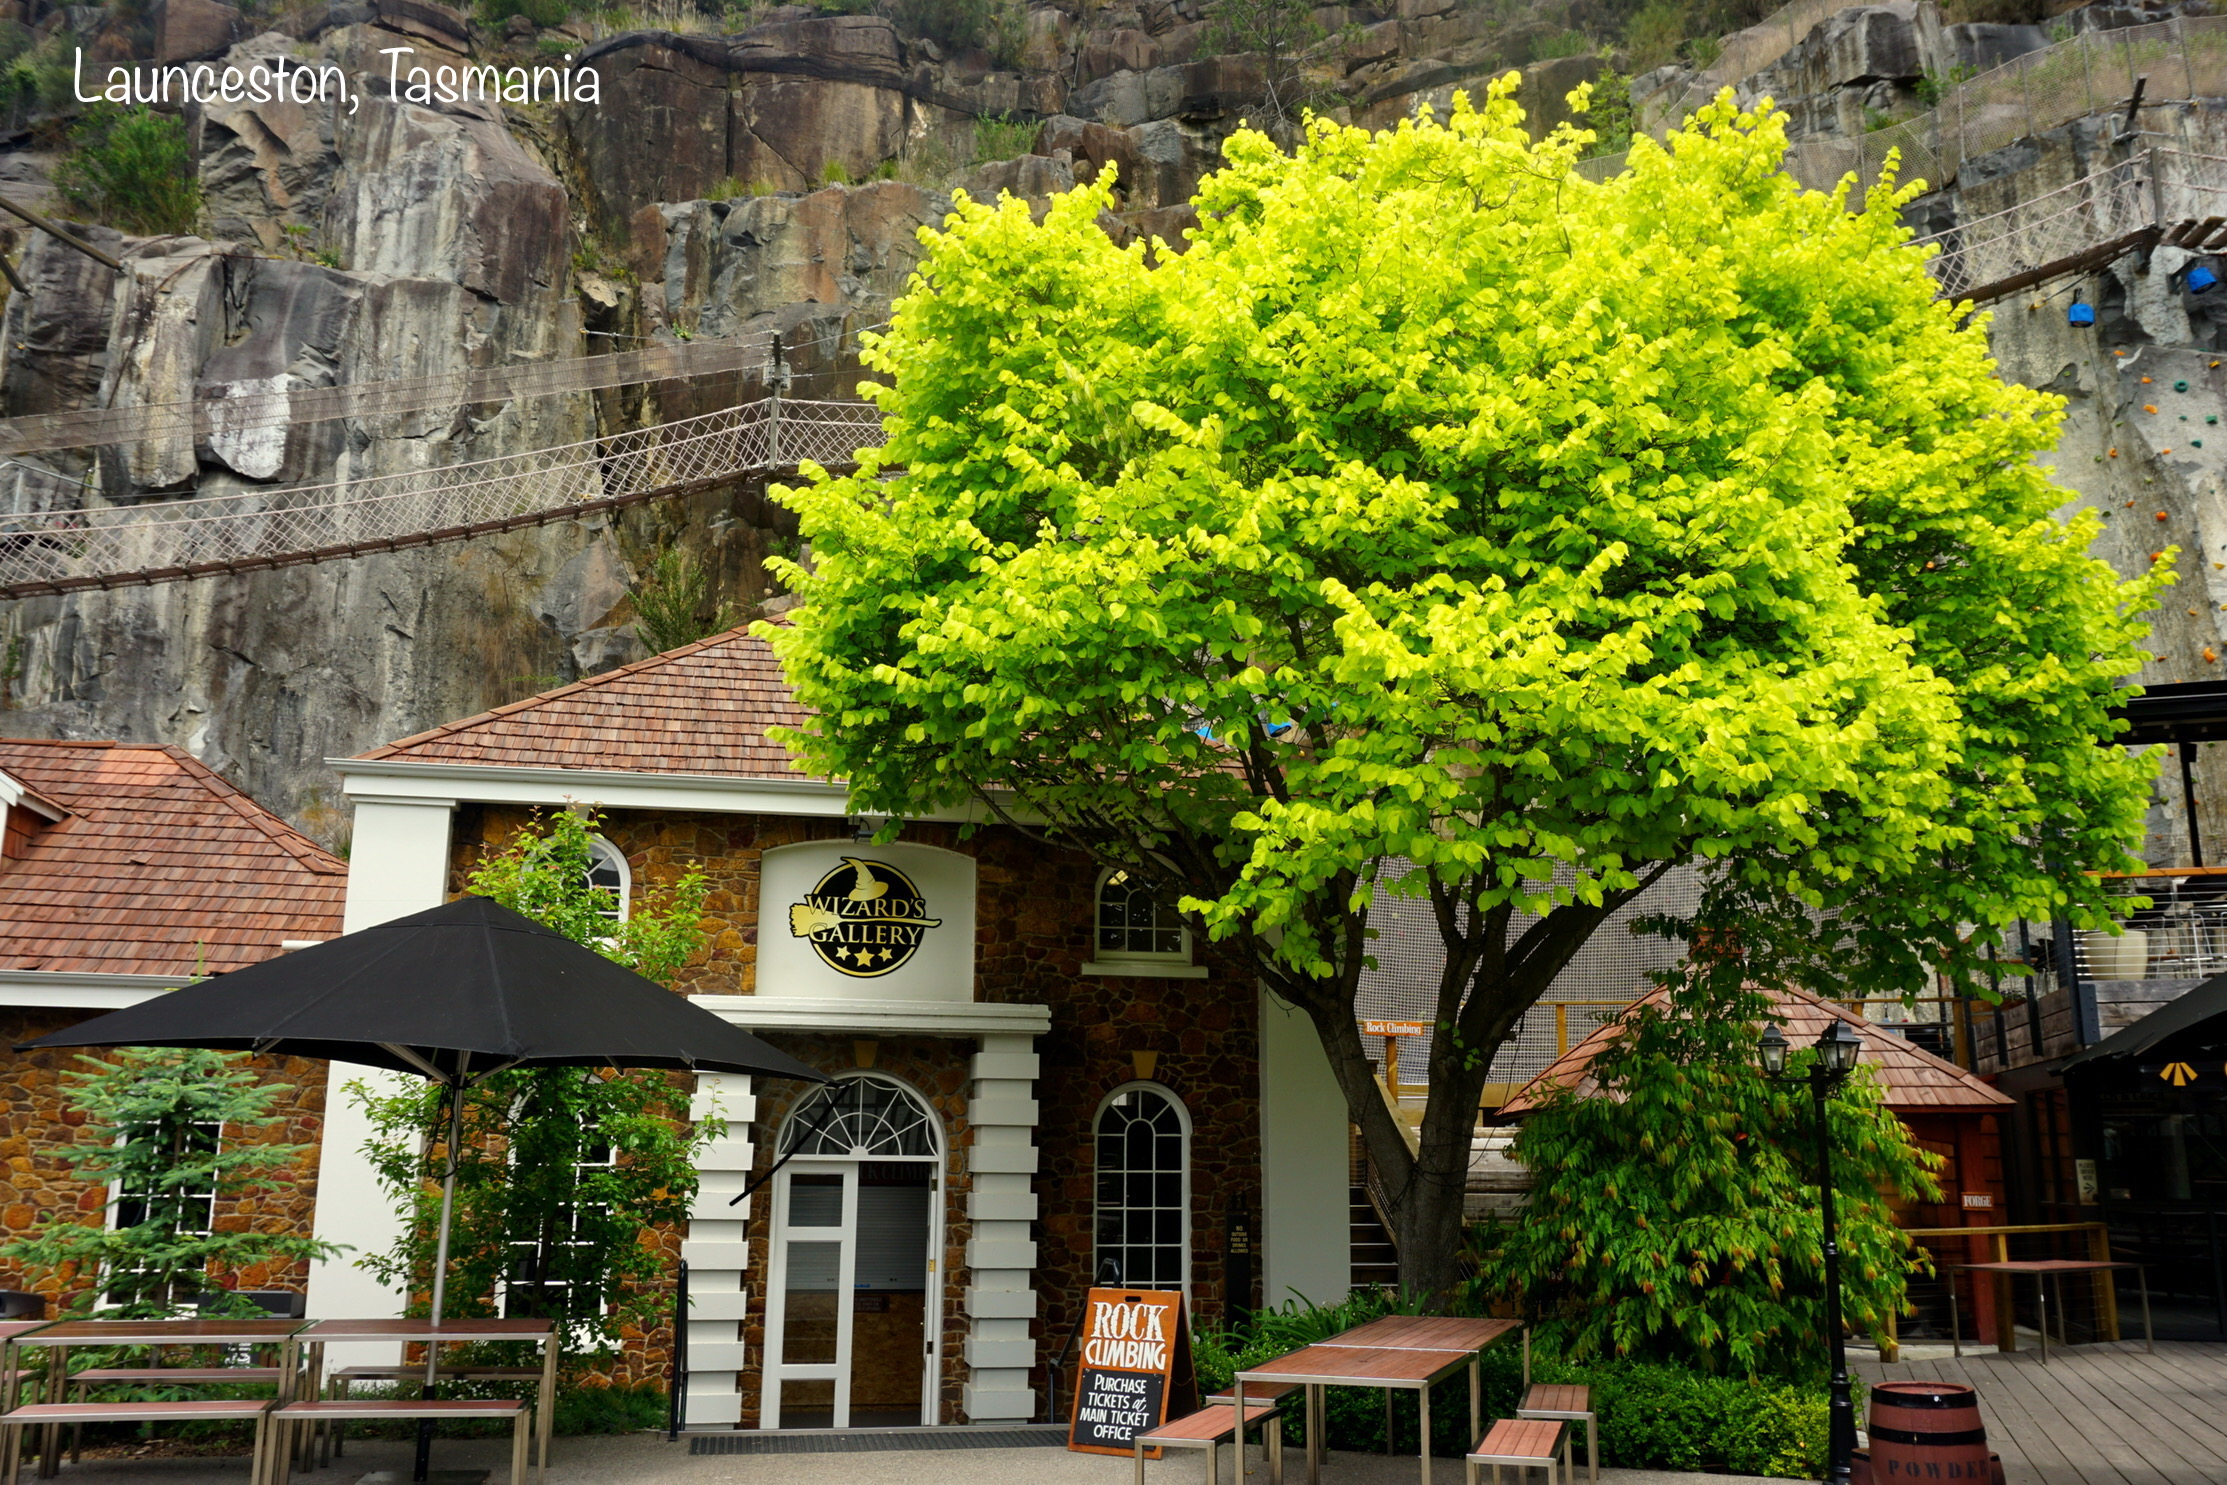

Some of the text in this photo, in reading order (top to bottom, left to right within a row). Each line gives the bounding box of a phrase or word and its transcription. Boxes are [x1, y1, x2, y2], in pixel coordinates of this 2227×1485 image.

[805, 896, 925, 918] WIZARD'S
[809, 922, 923, 945] GALLERY
[1366, 1022, 1421, 1034] Rock Climbing
[1963, 1195, 1992, 1207] FORGE
[1091, 1302, 1169, 1342] ROCK
[1085, 1339, 1167, 1370] CLIMBING
[1094, 1374, 1147, 1394] PURCHASE
[1088, 1392, 1146, 1412] TICKETS at
[1079, 1407, 1149, 1427] MAIN TICKET
[1093, 1424, 1132, 1441] OFFICE
[1888, 1459, 1987, 1479] POWDER
